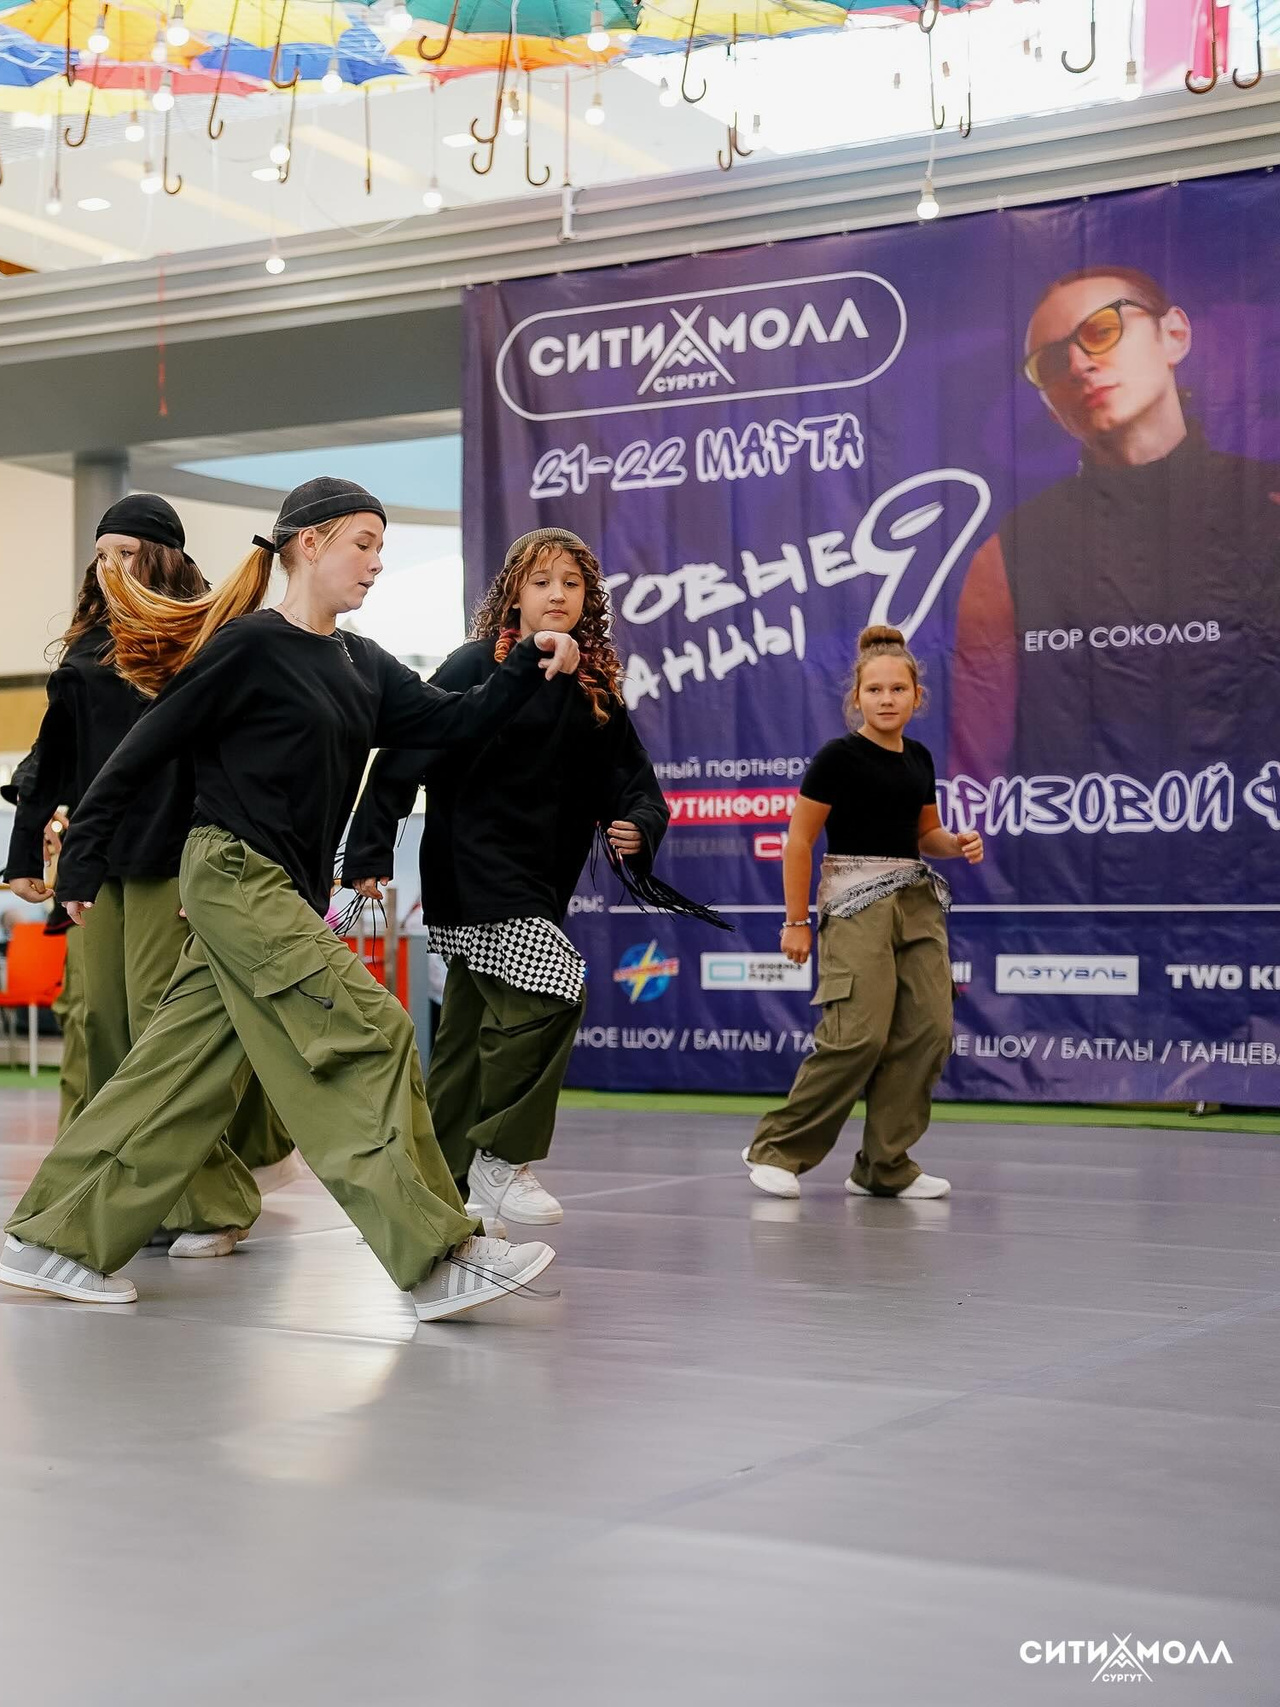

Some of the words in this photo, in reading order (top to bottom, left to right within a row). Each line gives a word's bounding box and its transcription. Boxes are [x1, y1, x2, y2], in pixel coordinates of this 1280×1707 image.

[528, 322, 666, 377] СИТИ
[708, 300, 870, 354] МОЛЛ
[653, 370, 720, 393] СУРГУТ
[529, 436, 688, 500] 21-22
[695, 411, 865, 482] МАРТА
[1024, 628, 1084, 652] ЕГОР
[1088, 620, 1221, 649] СОКОЛОВ
[1165, 964, 1243, 990] TWO
[622, 1027, 676, 1050] ШОУ
[693, 1028, 771, 1052] БАТТЛЫ
[975, 1034, 1037, 1059] ШОУ
[1060, 1037, 1154, 1063] БАТТЛЫ
[1179, 1040, 1280, 1068] ТАНЦЕВ
